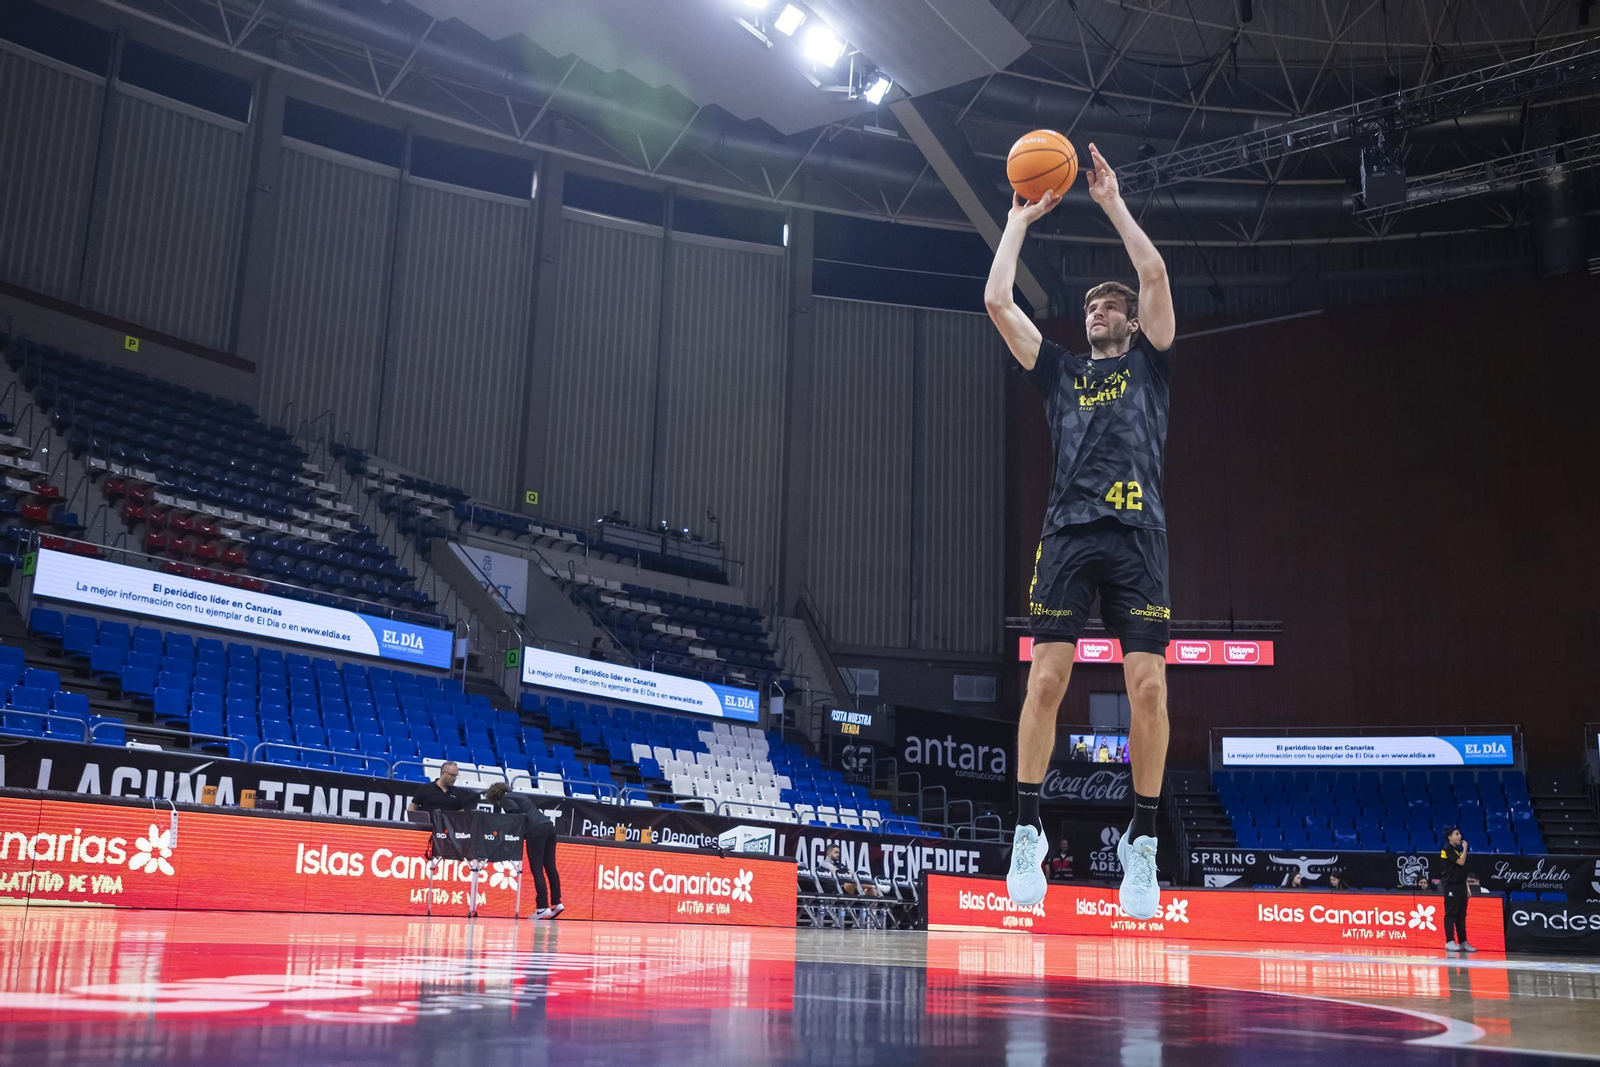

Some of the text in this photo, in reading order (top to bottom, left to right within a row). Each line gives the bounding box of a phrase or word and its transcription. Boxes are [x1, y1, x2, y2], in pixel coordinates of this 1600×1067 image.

[129, 339, 136, 348] P
[528, 493, 536, 502] Q
[1105, 480, 1143, 511] 42
[25, 556, 32, 571] P
[153, 583, 162, 593] El
[164, 586, 208, 602] periódico
[232, 600, 242, 608] en
[245, 601, 282, 616] Canarias
[76, 581, 88, 591] La
[90, 585, 118, 598] mejor
[119, 591, 173, 608] información
[176, 602, 192, 611] con
[194, 604, 204, 613] tu
[205, 608, 242, 622] ejemplar
[244, 613, 255, 623] de
[257, 616, 265, 625] El
[288, 623, 299, 631] en
[300, 626, 351, 641] www.eldia.es
[382, 629, 424, 650] EL DÍA
[509, 652, 516, 664] Q
[536, 670, 553, 679] mejor
[608, 683, 631, 693] ejemplar
[632, 686, 639, 694] de
[632, 677, 657, 688] Canarias
[724, 694, 738, 707] EL
[737, 696, 755, 710] DÍA
[841, 722, 860, 735] TIENDA
[904, 735, 1006, 774] antara
[1284, 744, 1316, 752] periódico
[1316, 752, 1343, 760] ejemplar
[1464, 741, 1507, 754] EL DÍA
[955, 769, 1006, 782] construcciones
[1039, 769, 1131, 801] Coca-Cola
[258, 779, 414, 822] TENERI
[581, 819, 640, 841] Pabeón
[295, 842, 364, 877] Islas
[779, 834, 872, 878] LAGNA
[1191, 852, 1256, 865] SPRING
[1089, 860, 1121, 872] ADEJ
[1491, 860, 1530, 883] López
[68, 874, 89, 893] DE
[91, 874, 123, 895] VIDA
[598, 864, 731, 896] Islas Canarias
[410, 888, 487, 906] LATTUD DE VDA
[959, 890, 985, 910] Islas
[1076, 897, 1097, 915] Islas
[677, 900, 731, 915] LATITUD DE VIDA
[1257, 903, 1406, 926] Islas Canarias
[1110, 920, 1164, 932] LATITUD DE VIDA
[1342, 928, 1407, 941] LATITUD DE VIDA
